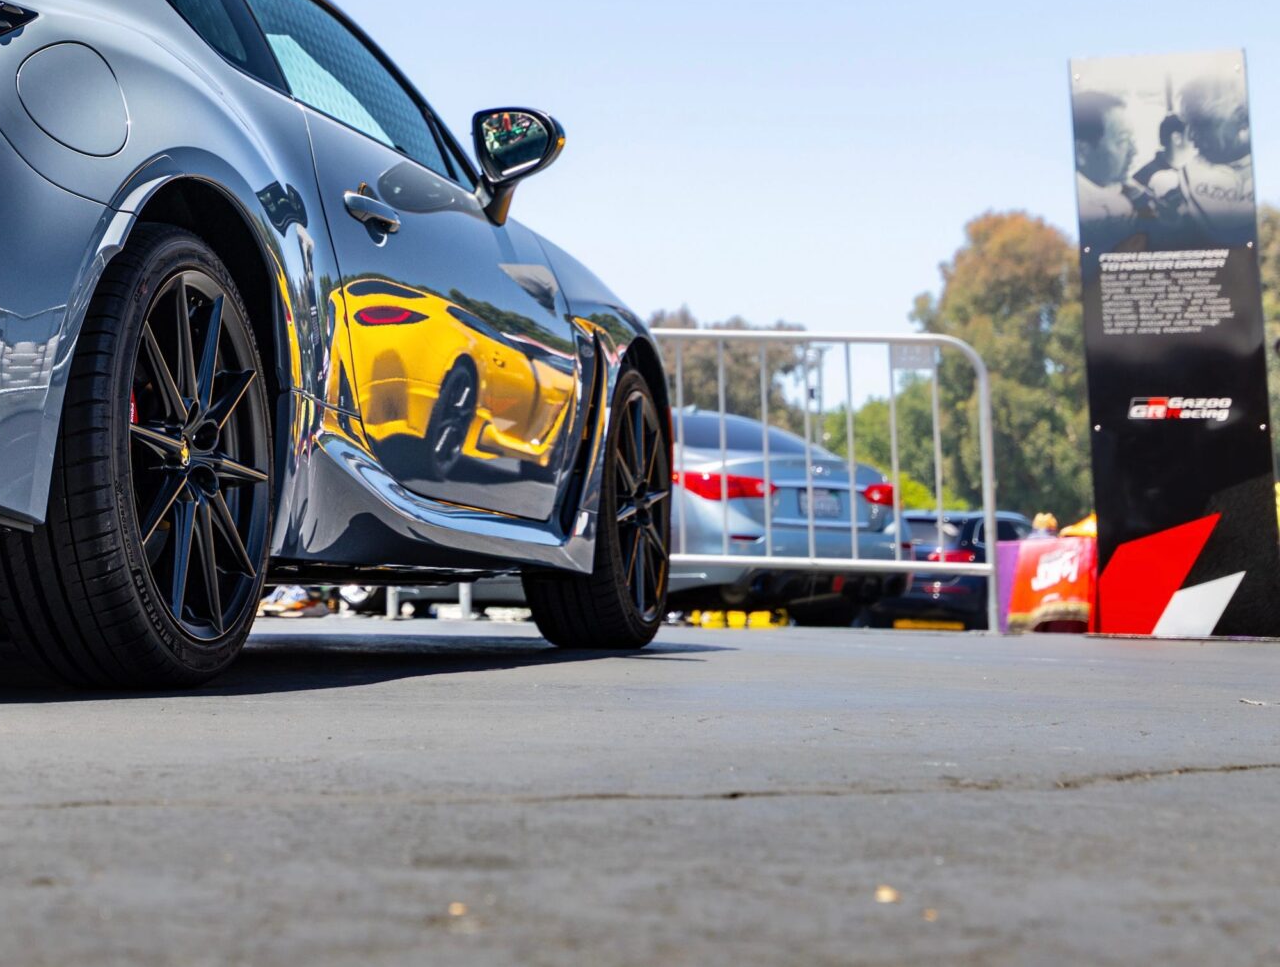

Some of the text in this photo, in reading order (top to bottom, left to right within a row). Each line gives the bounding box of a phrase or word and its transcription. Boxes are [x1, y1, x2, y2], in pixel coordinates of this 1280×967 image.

[1168, 397, 1233, 409] GAZOO
[1129, 404, 1167, 418] GR
[1166, 408, 1230, 422] Racing
[135, 574, 173, 646] MICHELIN
